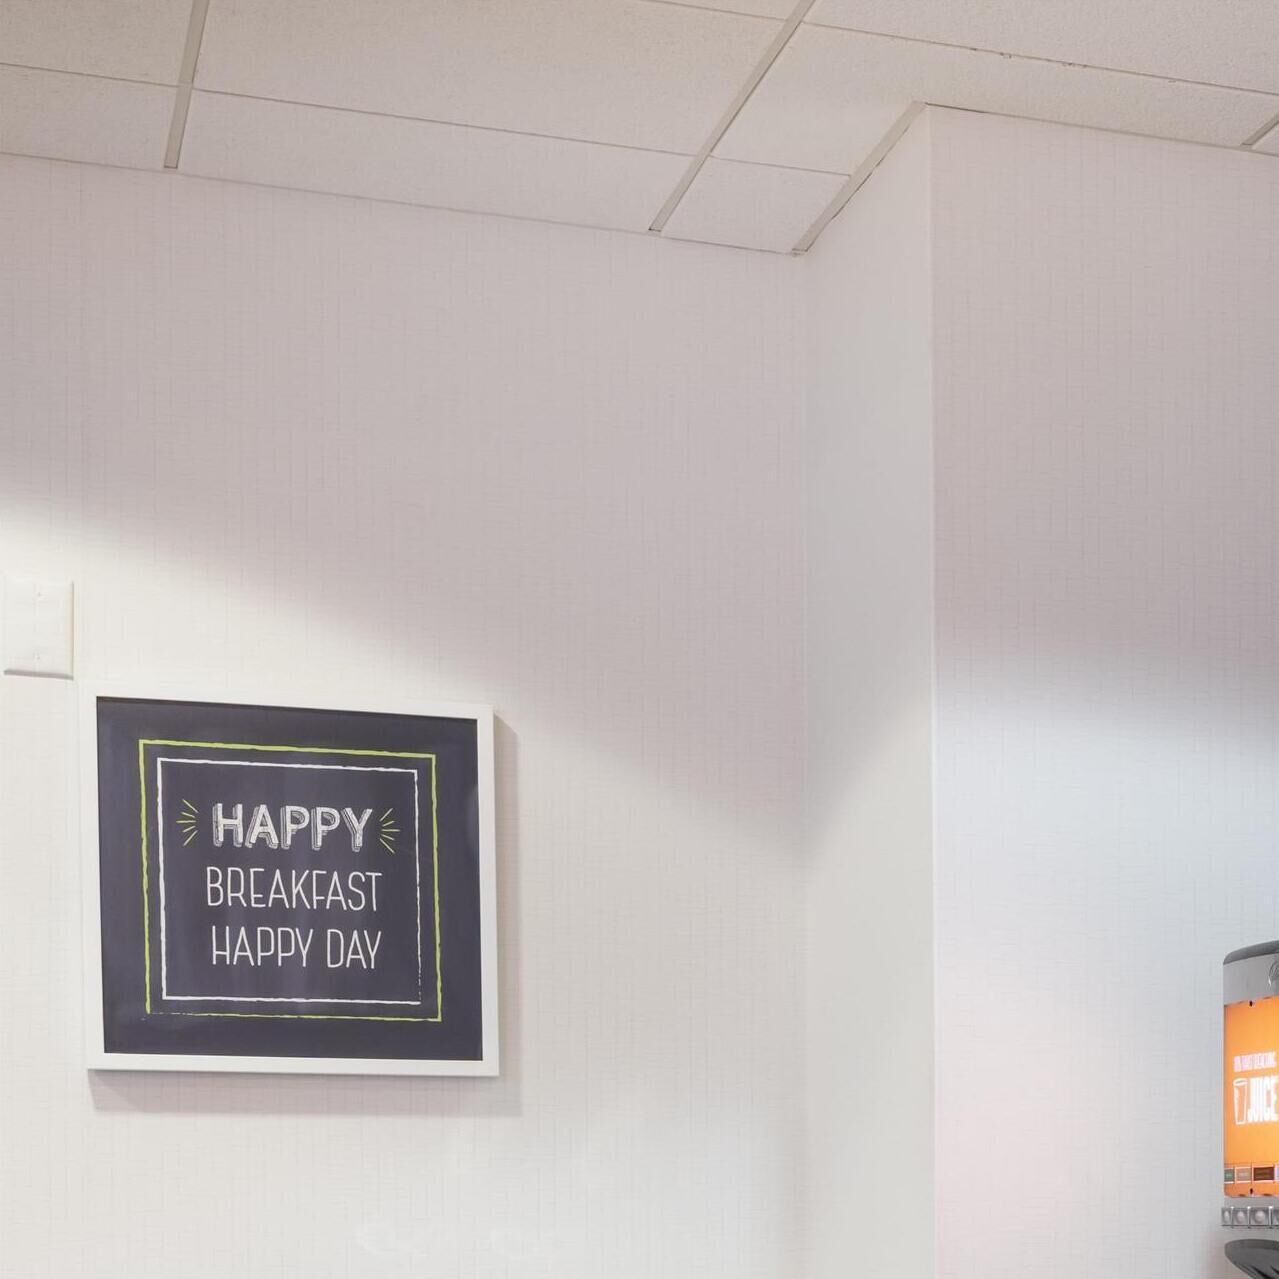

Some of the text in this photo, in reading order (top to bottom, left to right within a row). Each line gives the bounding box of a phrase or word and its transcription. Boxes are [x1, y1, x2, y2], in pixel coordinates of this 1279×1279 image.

[212, 803, 373, 852] HAPPY
[206, 866, 382, 911] BREAKFAST
[211, 925, 382, 969] HAPPY DAY
[1247, 1075, 1279, 1123] JUICE
